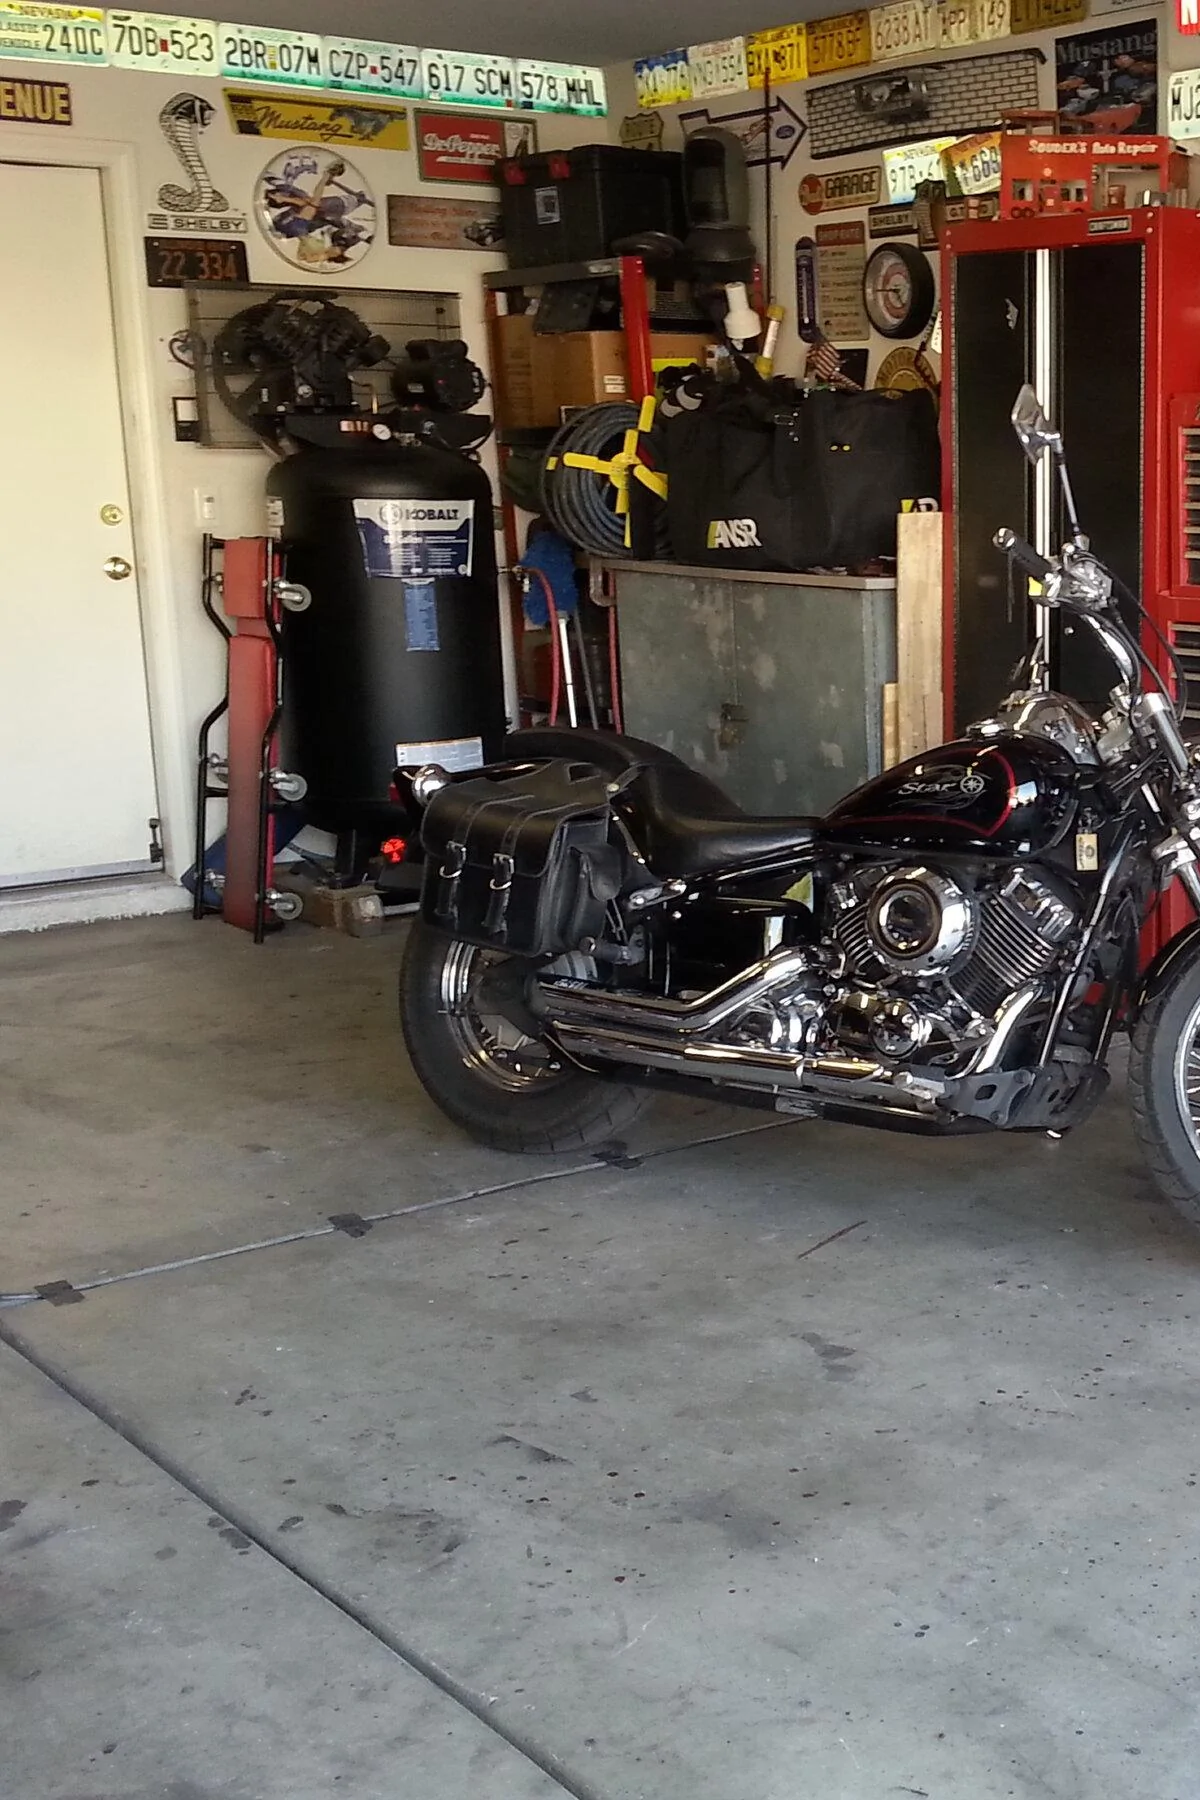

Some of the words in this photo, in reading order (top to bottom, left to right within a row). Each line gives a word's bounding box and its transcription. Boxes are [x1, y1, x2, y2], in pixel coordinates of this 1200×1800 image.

[171, 30, 214, 62] 523
[225, 37, 267, 68] 2BR
[1057, 30, 1156, 63] Mustang
[328, 49, 368, 80] CZP
[380, 55, 418, 86] 547
[428, 63, 465, 93] 617
[475, 68, 512, 98] SCM
[521, 72, 558, 101] 578
[256, 105, 345, 142] Mustang
[825, 171, 877, 198] GARAGE
[174, 217, 244, 231] SHELBY
[406, 509, 459, 520] KOBALT
